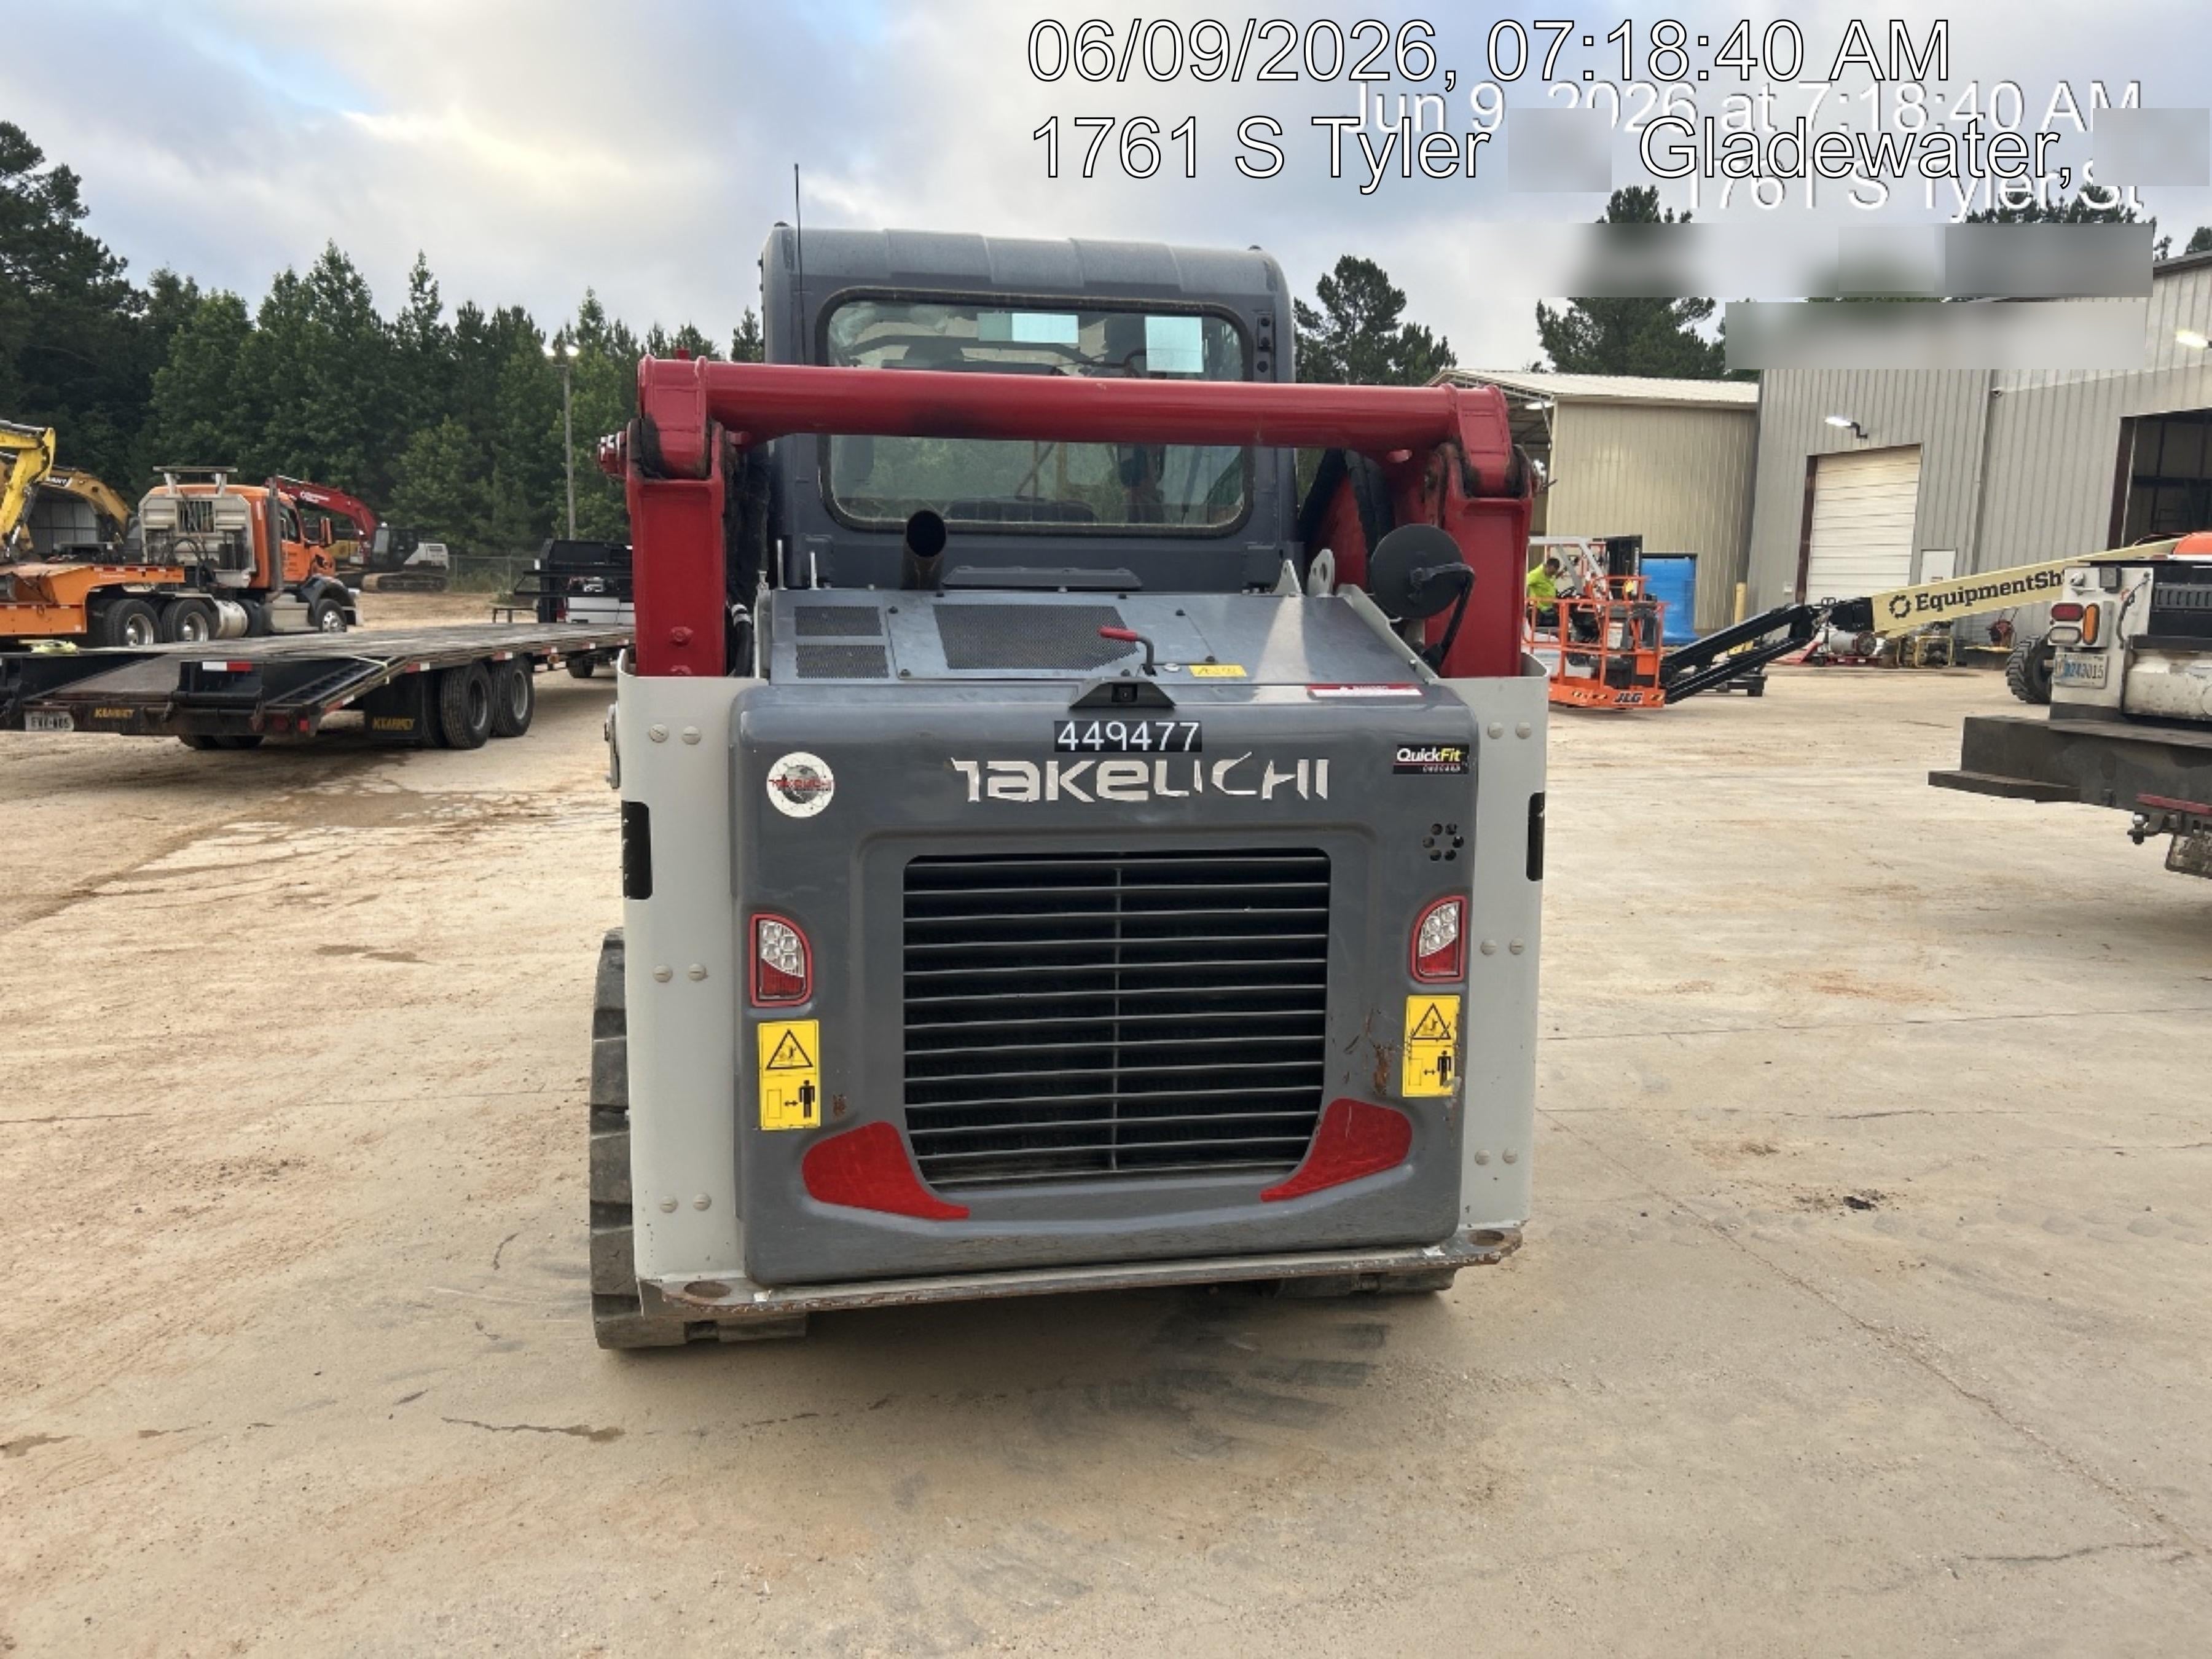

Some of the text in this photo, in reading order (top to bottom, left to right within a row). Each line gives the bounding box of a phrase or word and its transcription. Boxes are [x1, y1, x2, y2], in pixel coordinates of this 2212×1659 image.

[1615, 692, 1642, 702] JLG
[1057, 721, 1199, 751] 449477
[1397, 746, 1462, 762] QuickFit
